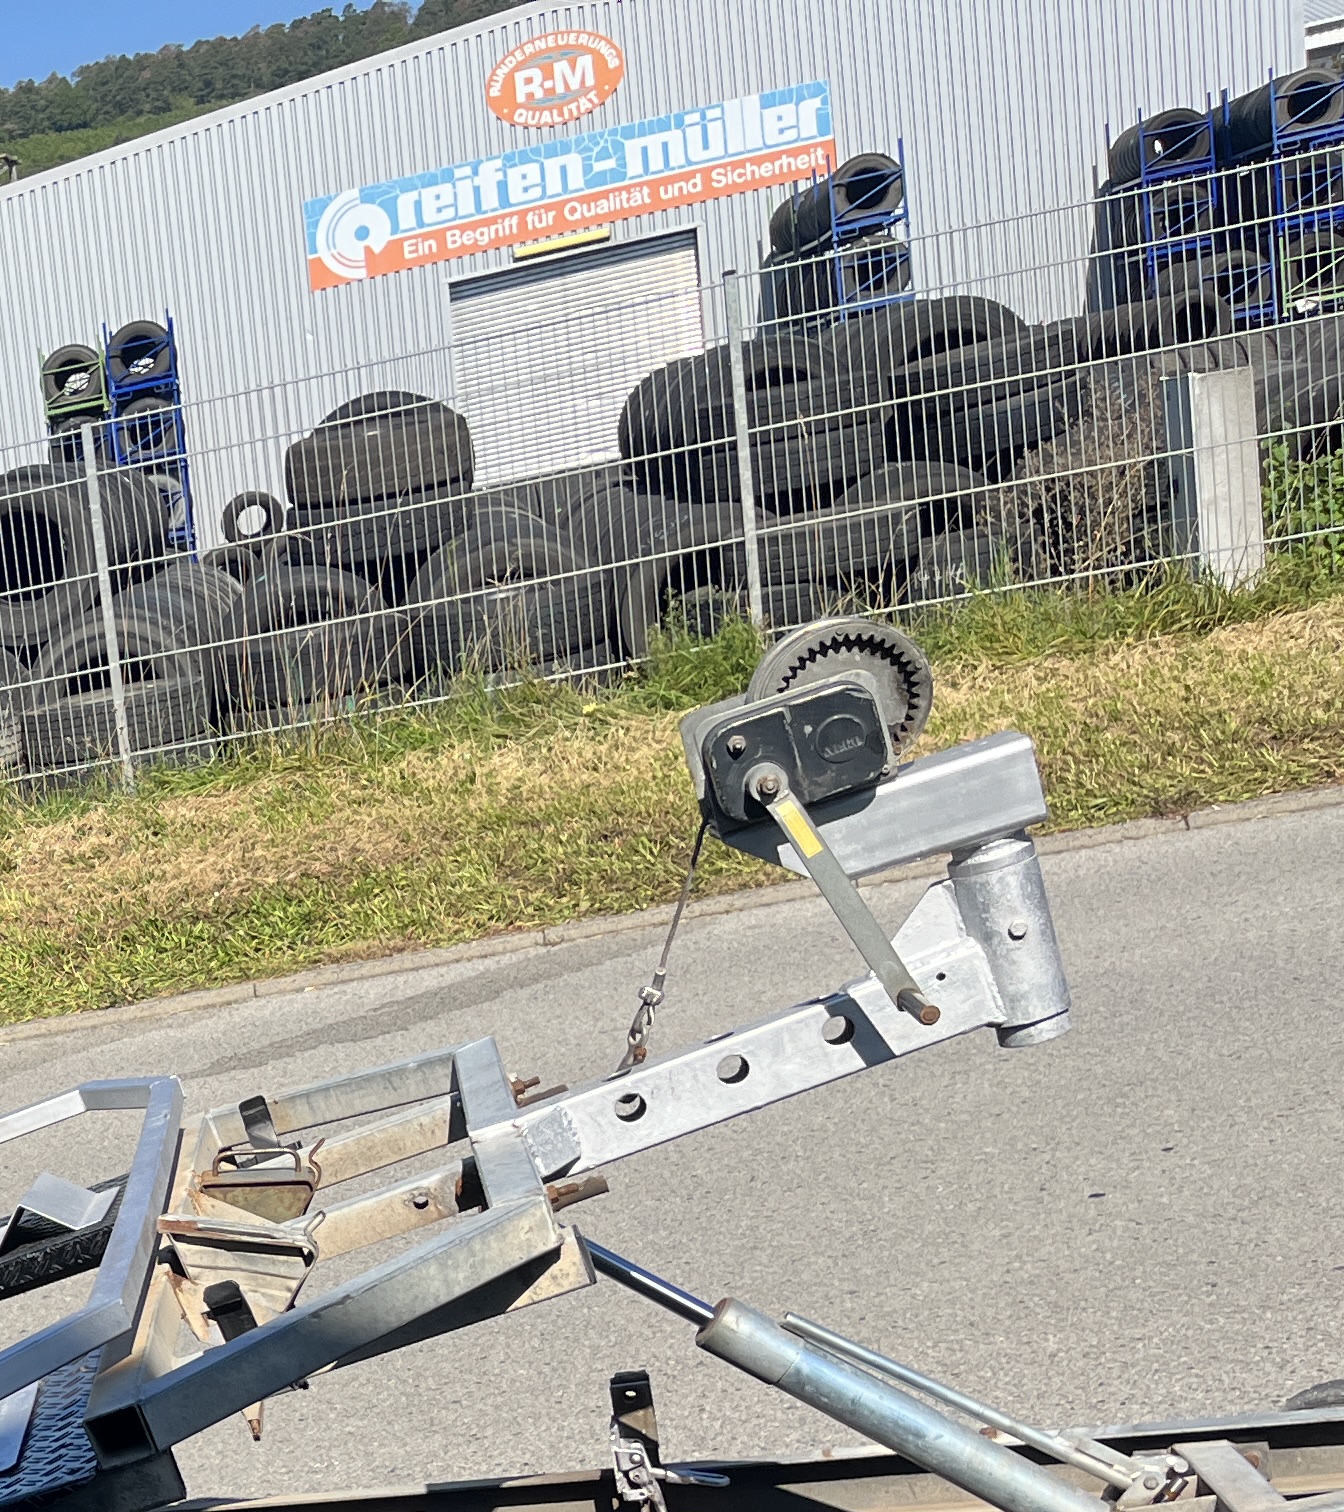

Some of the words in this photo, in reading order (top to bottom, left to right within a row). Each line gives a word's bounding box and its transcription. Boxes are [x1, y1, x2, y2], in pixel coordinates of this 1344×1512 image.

[489, 32, 620, 97] RUNDERNEUERUNGS
[513, 54, 596, 104] R-M
[513, 90, 600, 125] QUALITÄT
[397, 94, 828, 230] reifen-müller
[403, 237, 437, 260] Ein
[445, 214, 520, 250] Begriff
[525, 209, 557, 231] für
[563, 184, 652, 222] Qualität
[659, 172, 703, 200] und
[710, 146, 827, 189] Sicherheit
